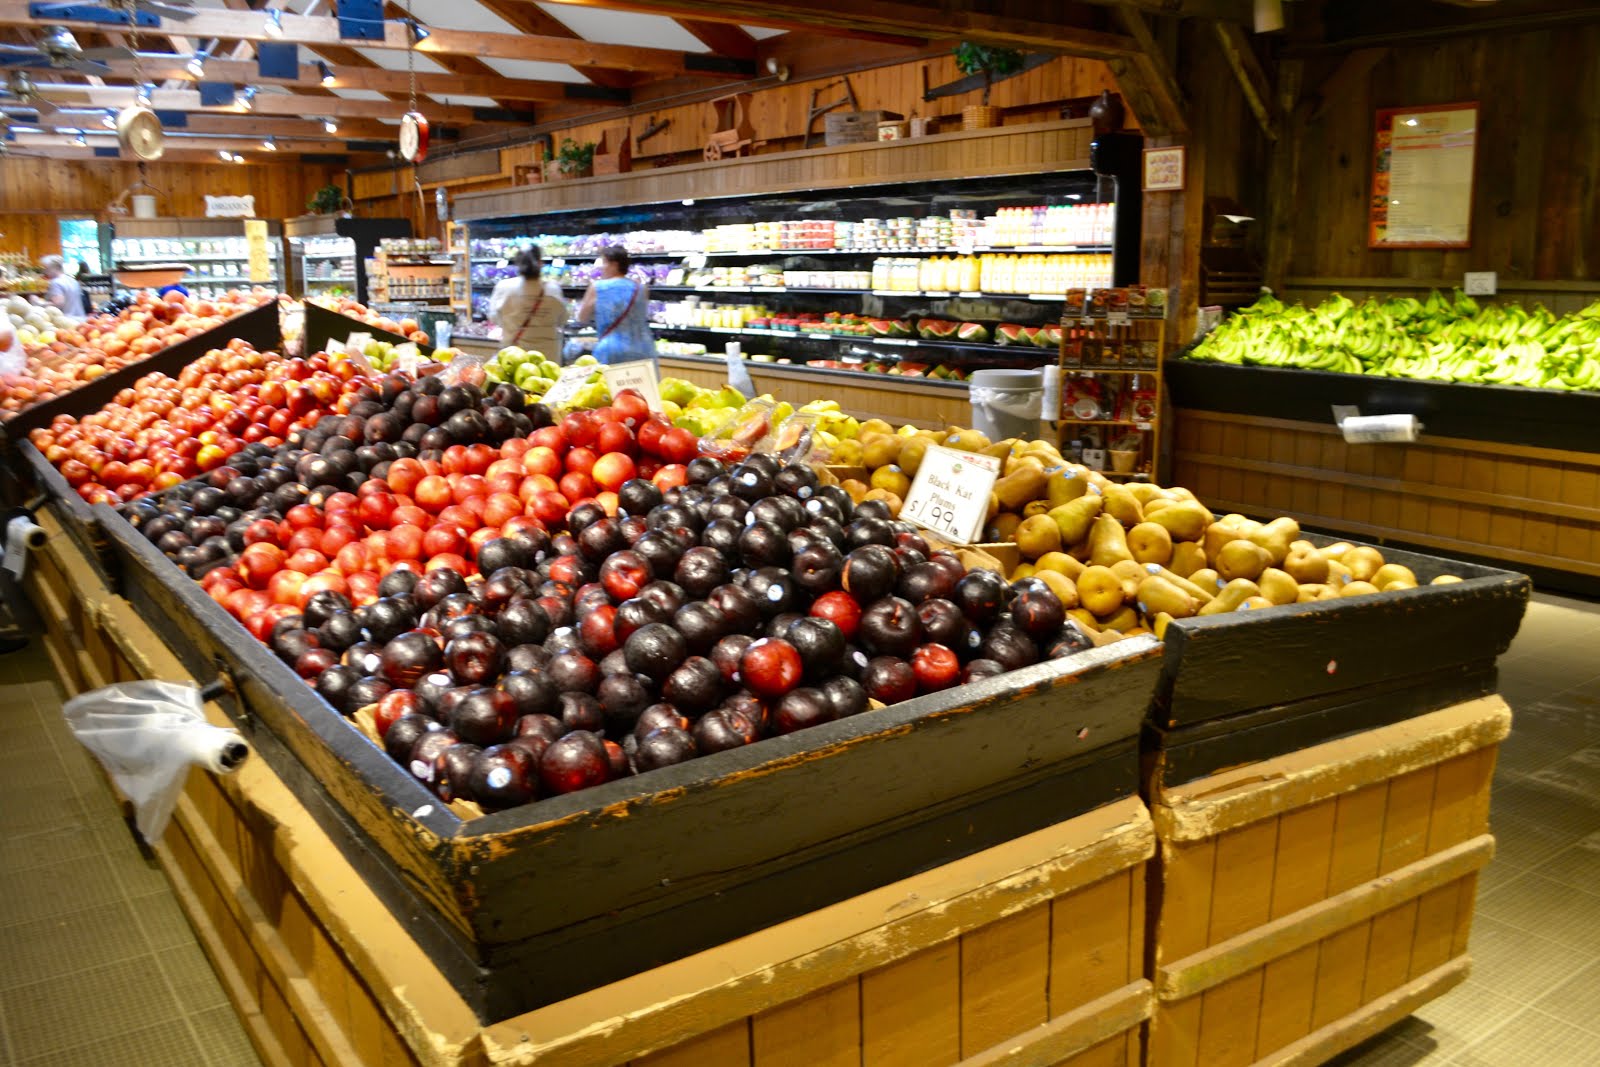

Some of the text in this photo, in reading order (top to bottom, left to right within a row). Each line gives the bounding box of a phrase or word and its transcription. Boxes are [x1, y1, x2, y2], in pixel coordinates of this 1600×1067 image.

[928, 474, 973, 500] Black Kat
[930, 492, 956, 511] Plums
